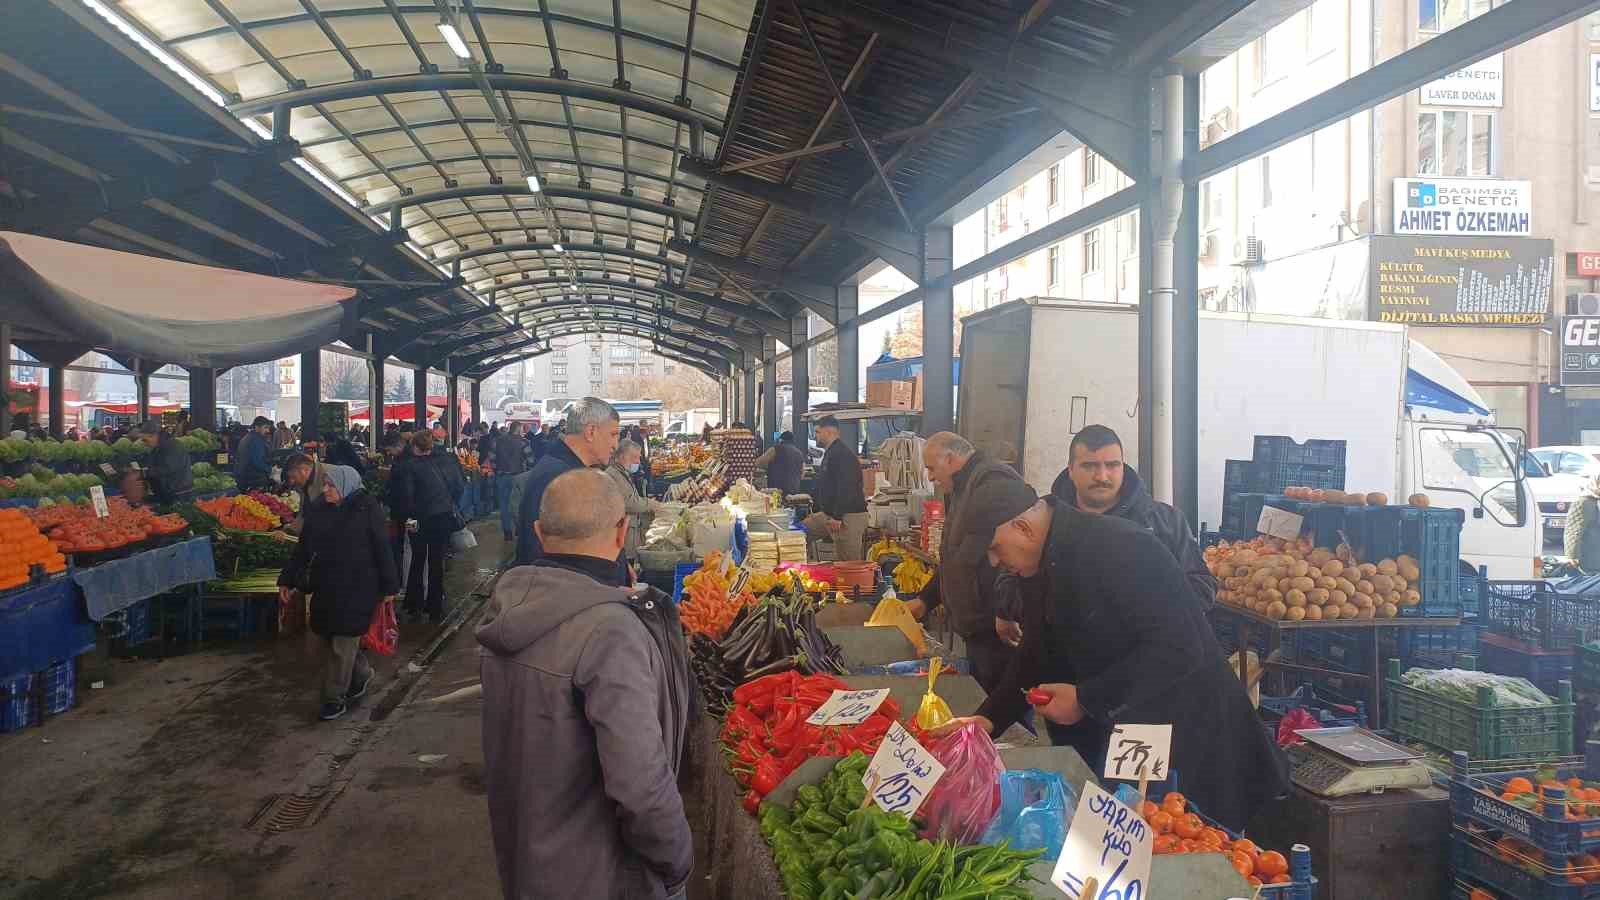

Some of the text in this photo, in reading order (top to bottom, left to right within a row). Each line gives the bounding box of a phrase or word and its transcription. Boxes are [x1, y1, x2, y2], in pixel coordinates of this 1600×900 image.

[1399, 207, 1529, 233] AHMET ÖZKEMAH
[875, 772, 922, 812] 125
